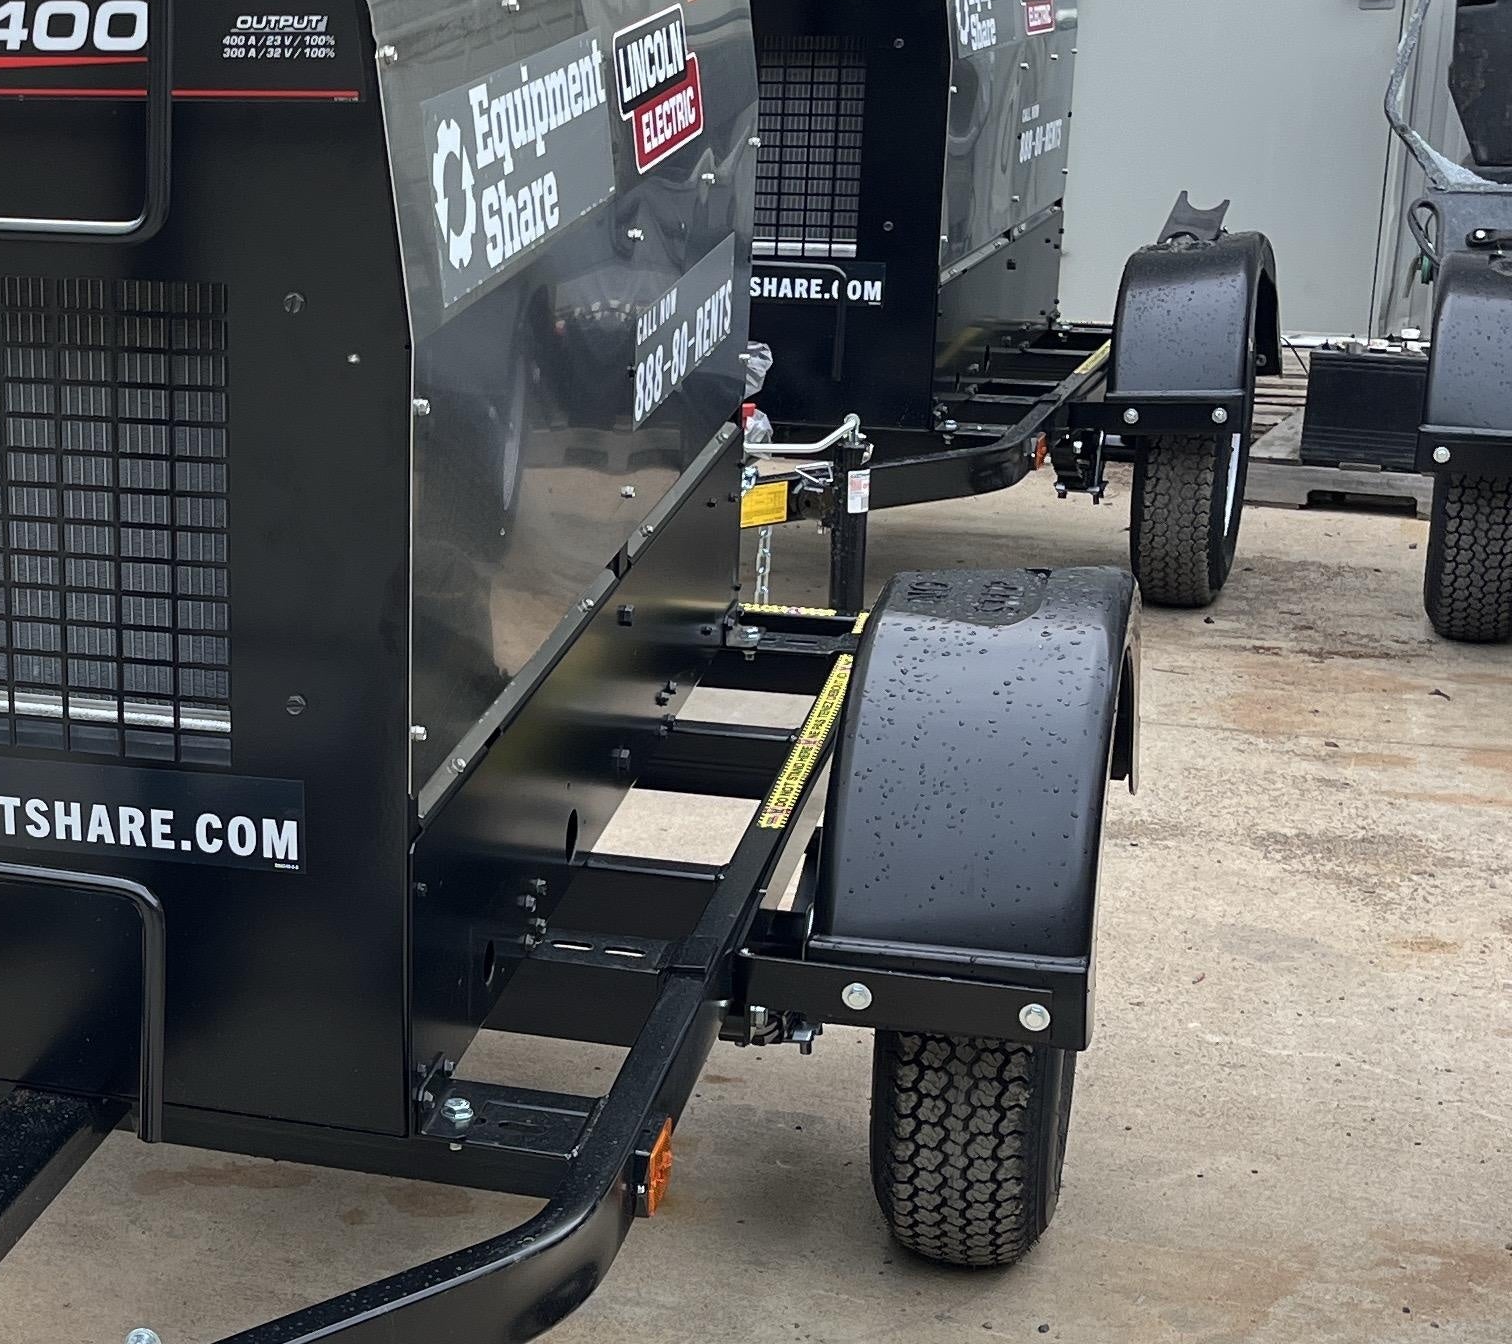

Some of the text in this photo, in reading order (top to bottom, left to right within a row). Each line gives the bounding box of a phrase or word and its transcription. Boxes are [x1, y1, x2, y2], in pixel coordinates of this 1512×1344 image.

[223, 36, 245, 46] 400
[248, 36, 256, 46] A
[266, 36, 281, 46] 23
[284, 36, 292, 46] V
[304, 36, 335, 46] 100%
[223, 48, 245, 58] 300
[248, 48, 256, 58] A
[266, 48, 281, 58] 32
[284, 48, 292, 58] V
[304, 48, 335, 58] 100%
[236, 16, 322, 29] OUTPUT
[618, 21, 685, 104] LINCOLN
[468, 38, 606, 175] Equipment
[642, 86, 696, 154] ELECTRIC
[481, 169, 559, 269] Share
[635, 280, 732, 421] 888-80-RENTS
[637, 306, 657, 345] CALL
